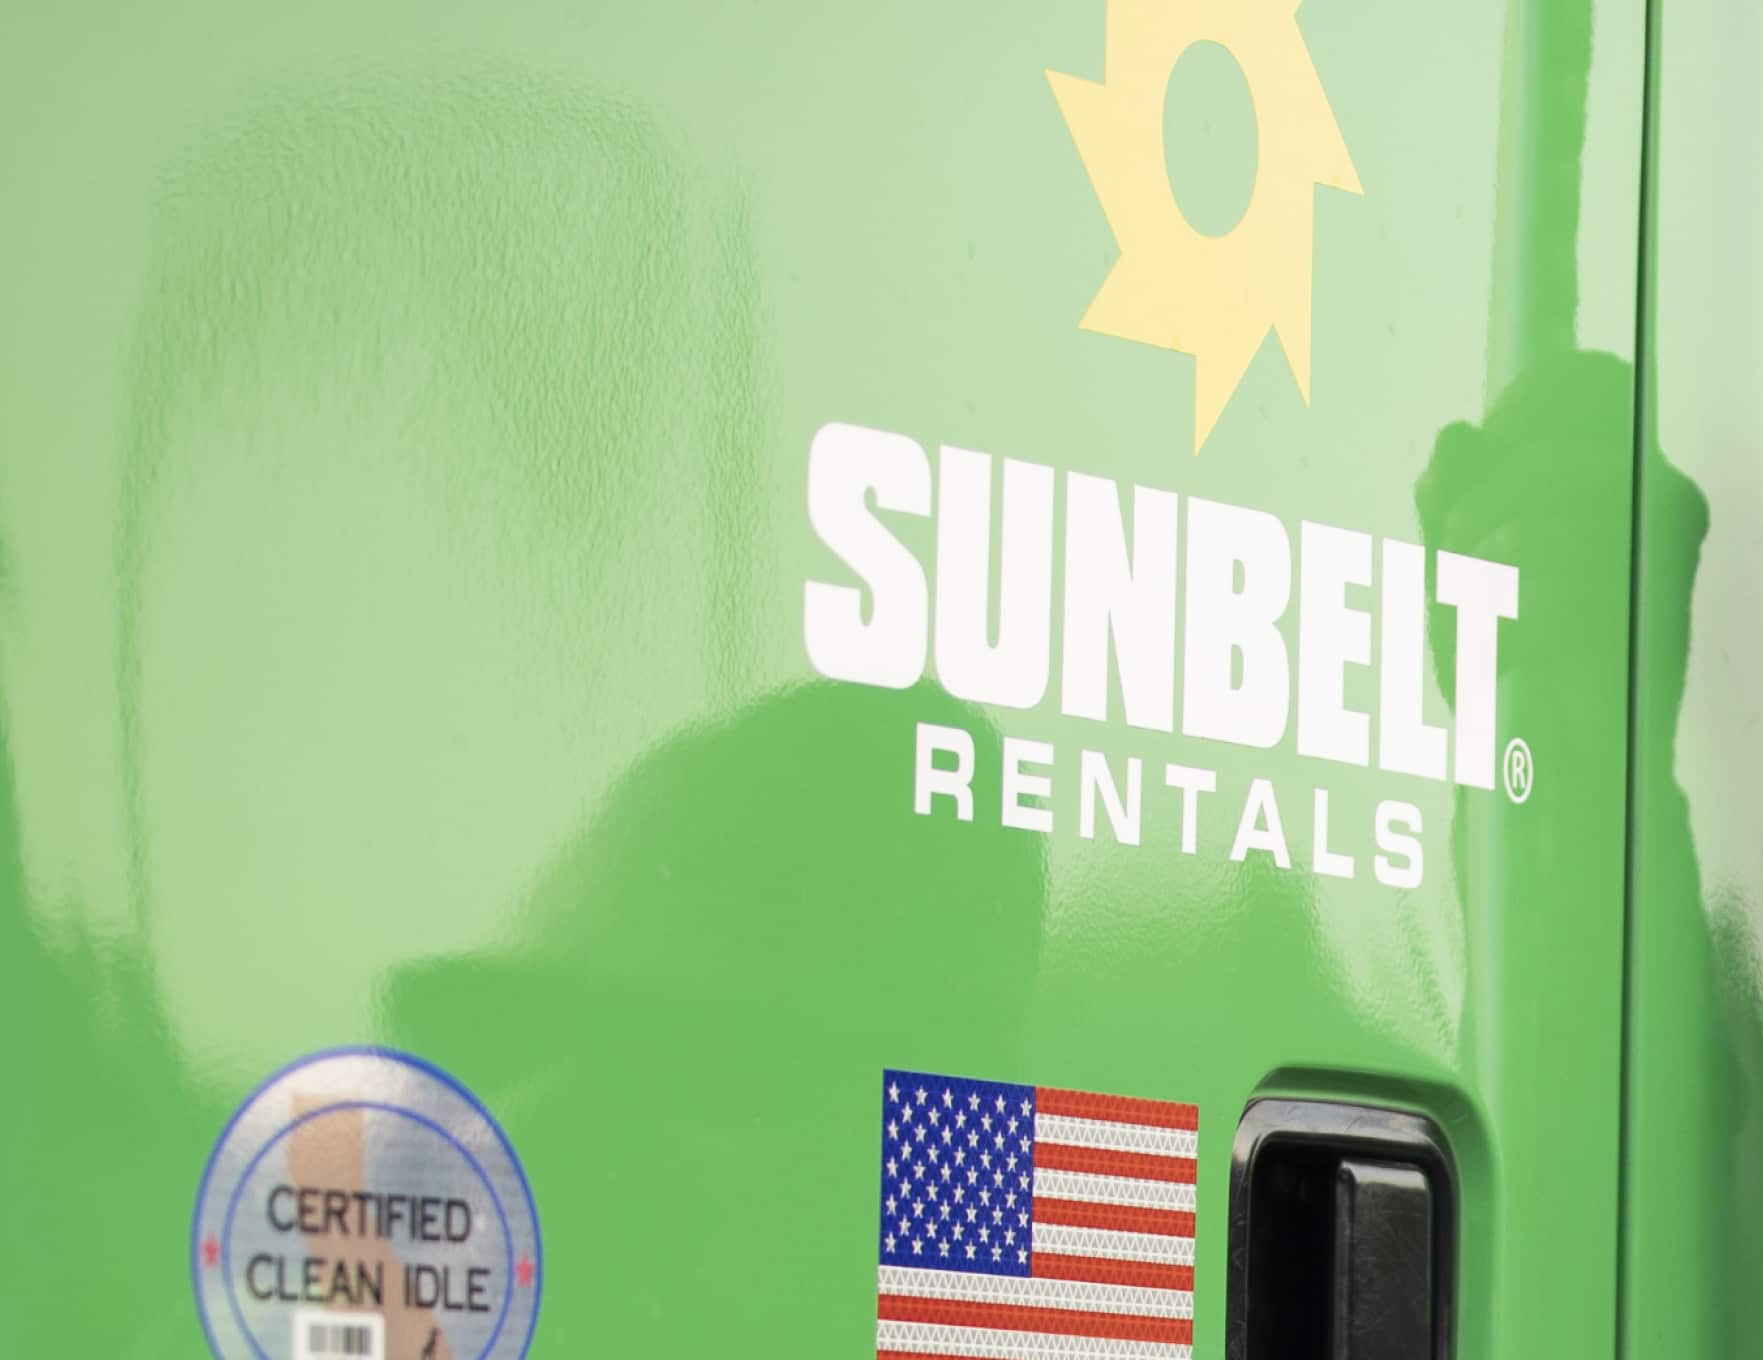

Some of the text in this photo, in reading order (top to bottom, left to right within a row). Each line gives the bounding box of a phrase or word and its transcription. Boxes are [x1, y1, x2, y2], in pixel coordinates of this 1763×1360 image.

[914, 721, 1425, 890] RENTALS
[266, 1184, 473, 1244] CERTIFIED
[246, 1253, 492, 1313] CLEAN IDLE
